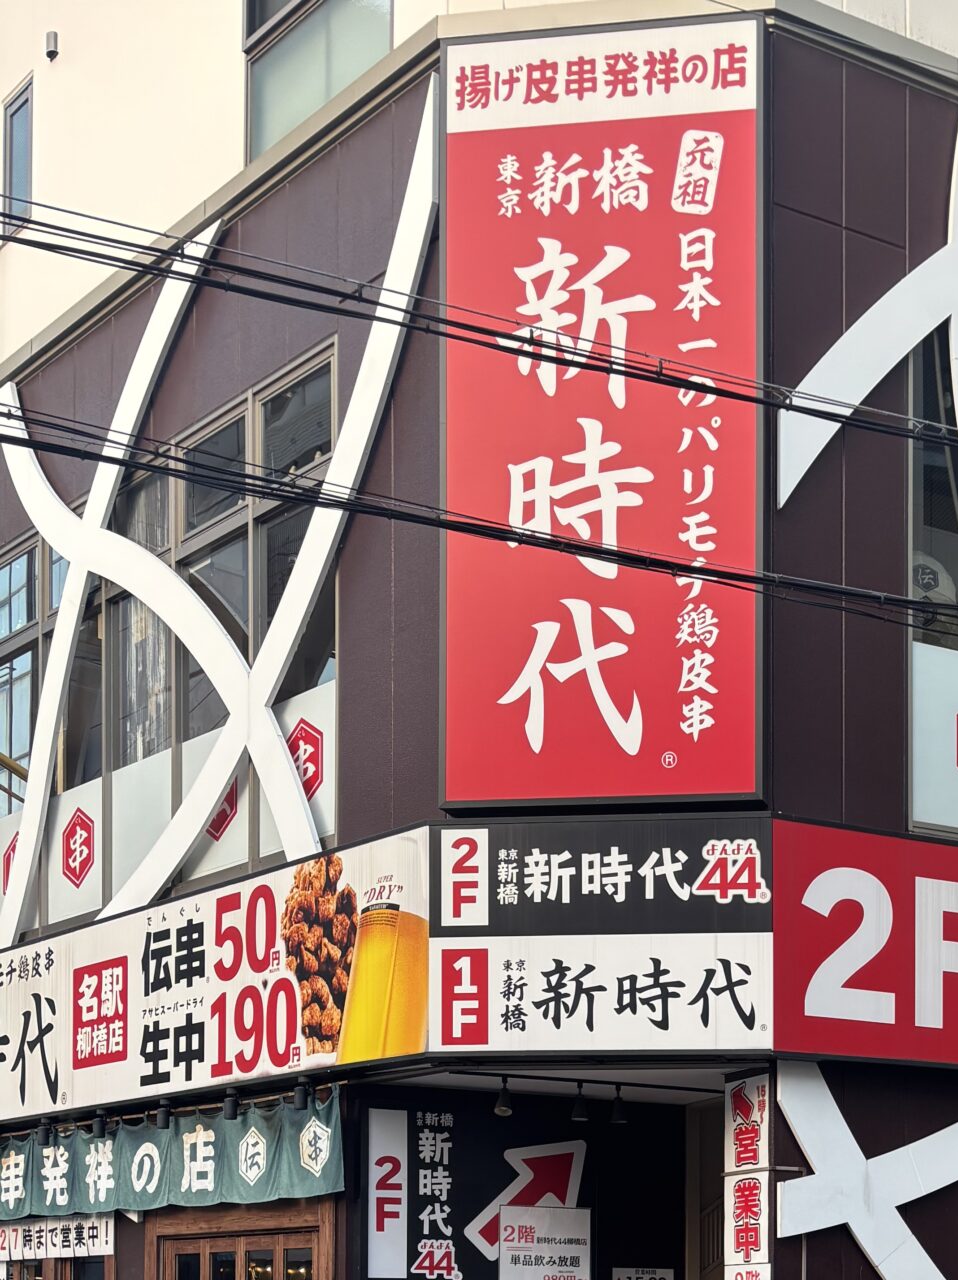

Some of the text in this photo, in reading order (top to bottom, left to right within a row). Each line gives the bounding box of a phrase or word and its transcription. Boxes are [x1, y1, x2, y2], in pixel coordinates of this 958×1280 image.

[455, 43, 748, 111] 揚げ皮串発祥の店
[496, 143, 654, 218] 東京 新橋
[674, 136, 717, 208] 元祖
[496, 237, 656, 755] 新時代
[69, 825, 89, 878] 串
[451, 837, 479, 918] 2F
[496, 862, 519, 905] 新橋
[498, 849, 518, 860] 東京
[147, 904, 200, 926] でんぐし
[141, 919, 206, 997] 伝串
[502, 959, 526, 971] 東京
[77, 966, 124, 1022] 名駅
[142, 997, 204, 1019] アサヒスーパードライ
[453, 956, 479, 1038] 1F
[500, 957, 755, 1032] 新橋 新時代
[0, 993, 58, 1107] 代
[76, 1019, 124, 1060] 柳橋店
[140, 1013, 205, 1086] 生中
[425, 1112, 453, 1127] 新橋
[374, 1155, 402, 1232] 2F
[419, 1129, 452, 1236] 新時代
[733, 1124, 761, 1262] 営業中
[503, 1225, 535, 1244] 2階
[510, 1254, 580, 1268] 単品飲み放題
